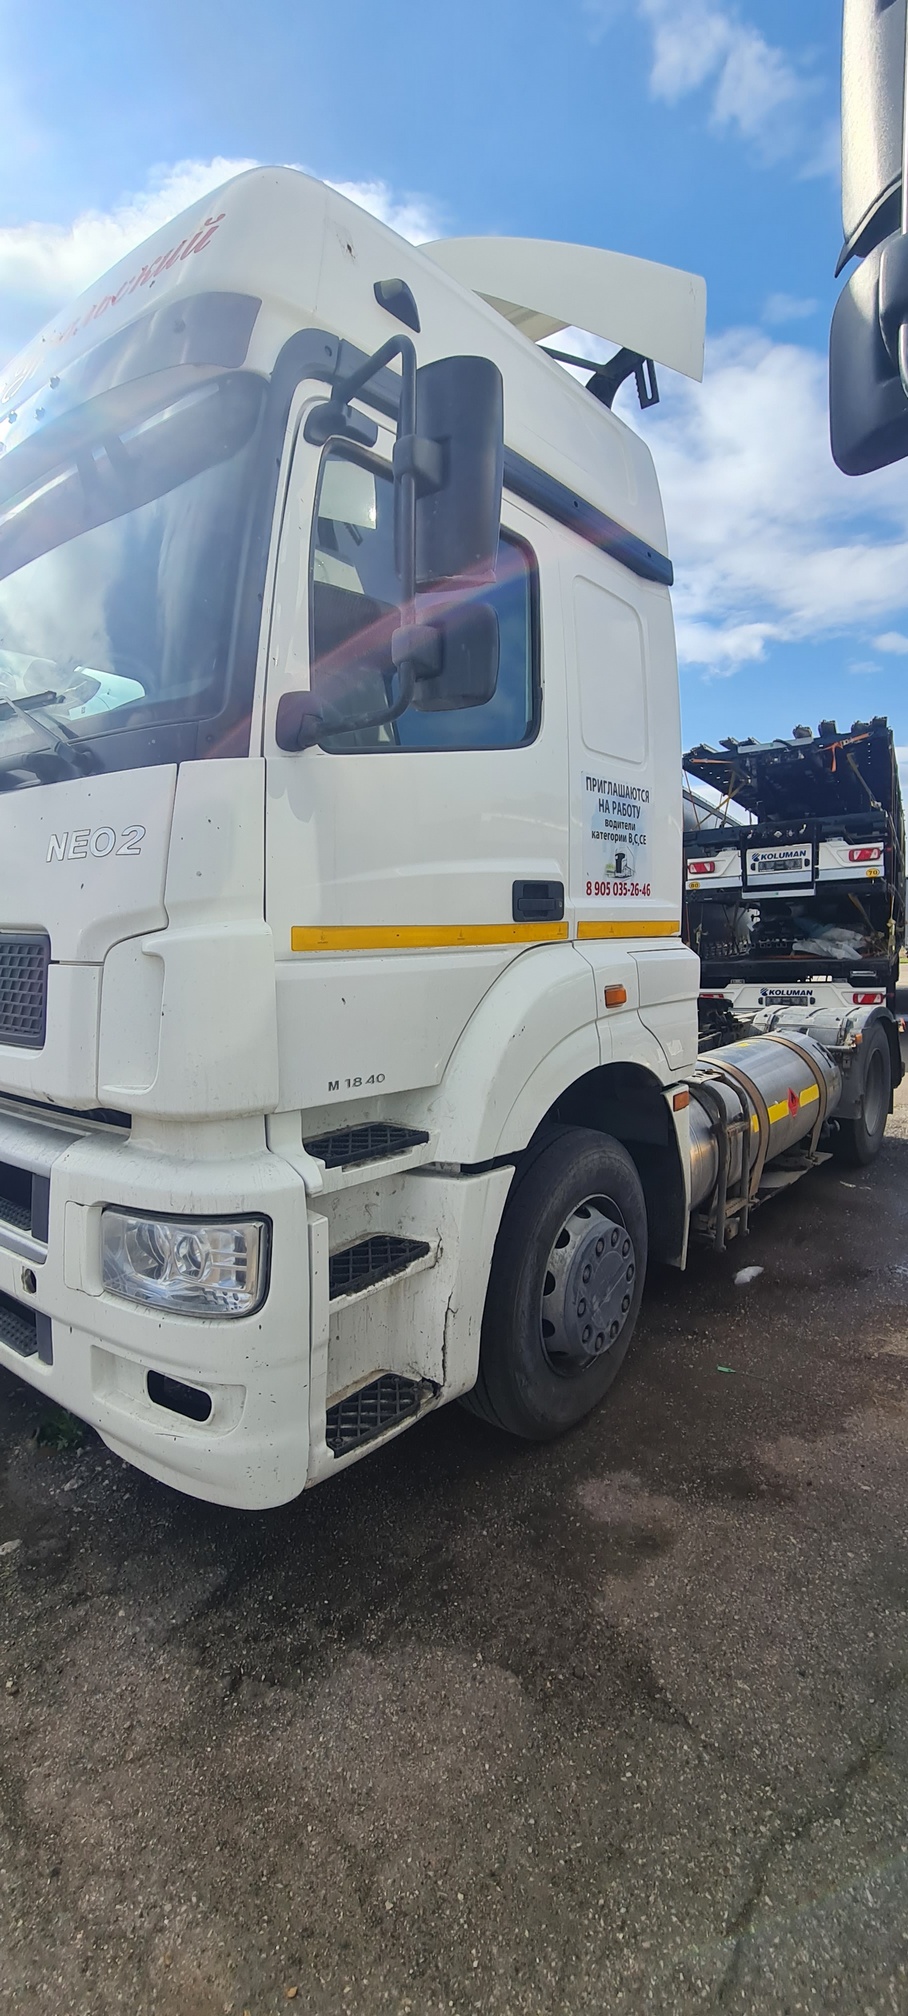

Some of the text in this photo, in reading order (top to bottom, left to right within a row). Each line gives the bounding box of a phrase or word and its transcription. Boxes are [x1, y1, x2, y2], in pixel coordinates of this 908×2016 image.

[585, 776, 650, 803] ПРИГЛАШАЮТСЯ
[598, 798, 641, 819] НА РАБОТУ
[604, 818, 636, 831] водители
[591, 830, 627, 845] категории
[760, 850, 807, 860] KOLUMAN
[586, 881, 651, 896] 8 905 035-26-46
